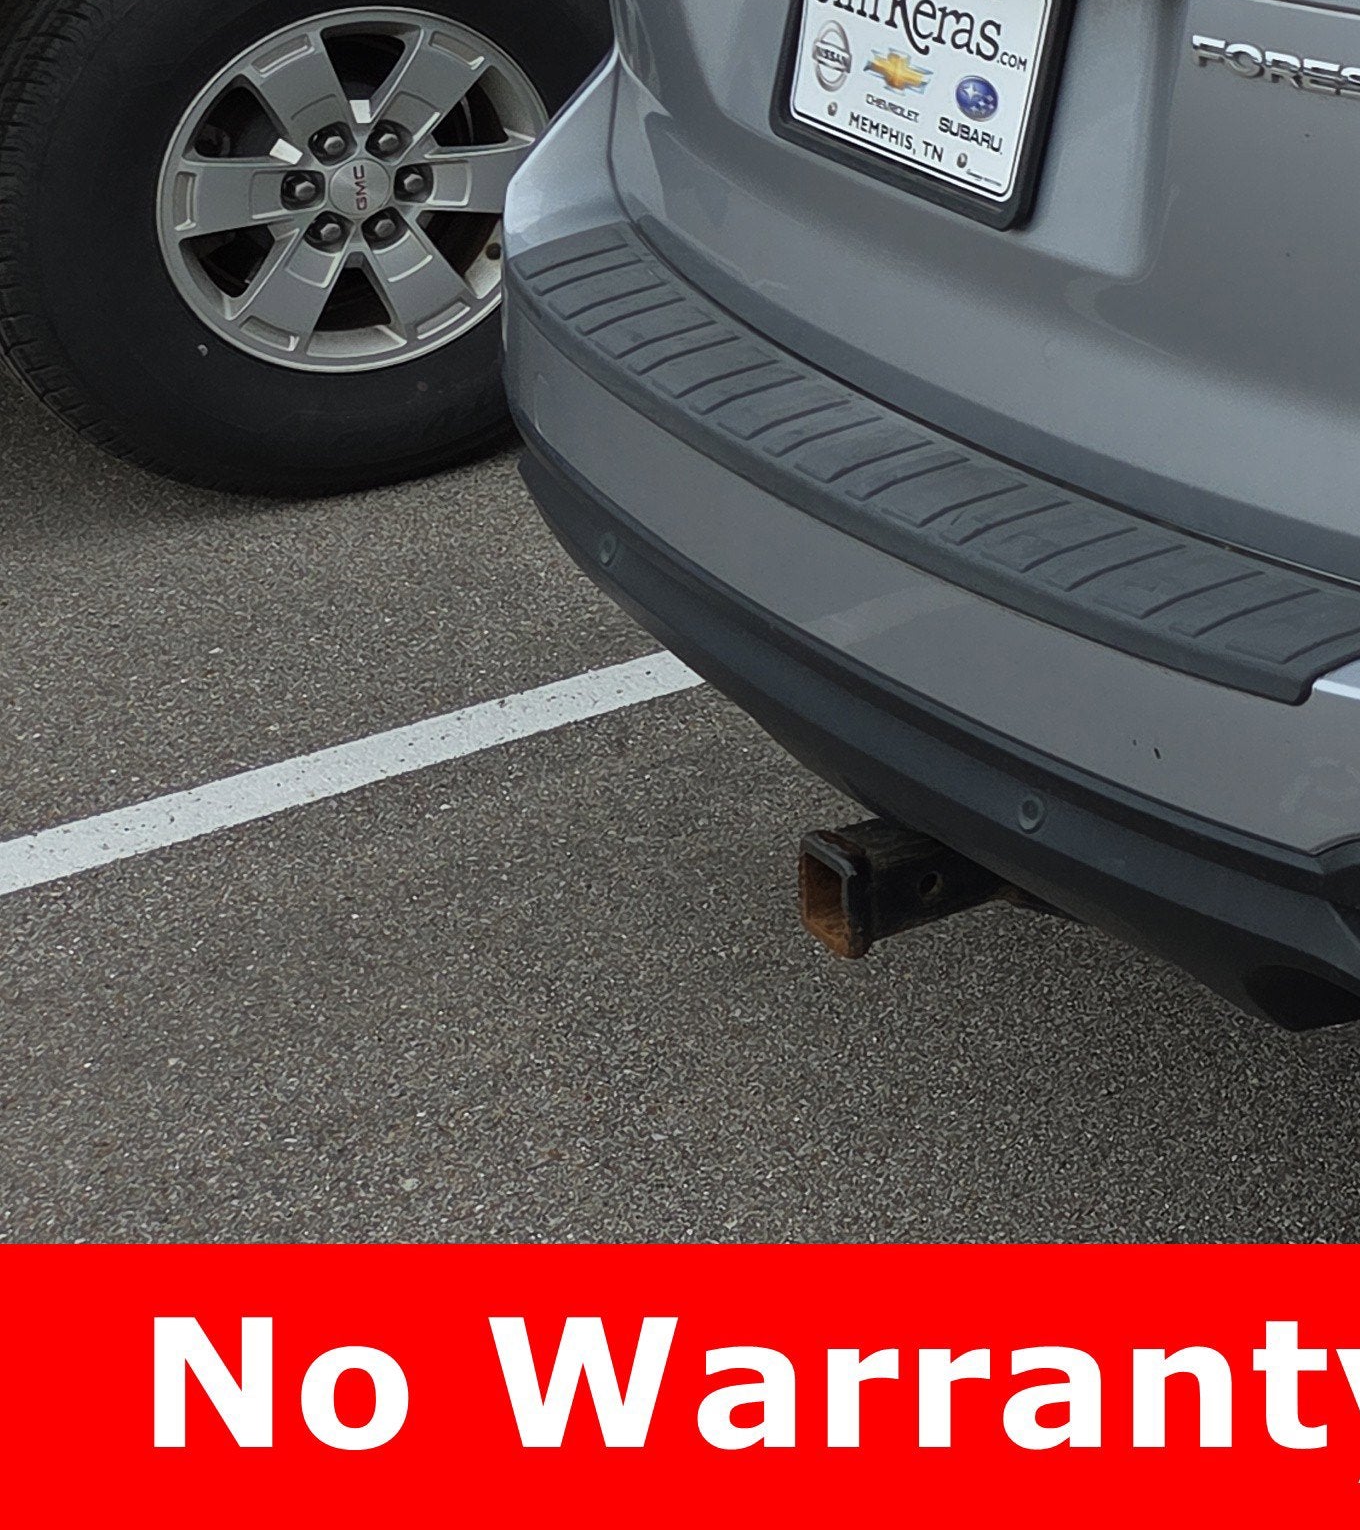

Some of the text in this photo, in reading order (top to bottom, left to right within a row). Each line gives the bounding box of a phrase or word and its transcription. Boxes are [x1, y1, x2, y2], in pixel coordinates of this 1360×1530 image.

[849, 111, 944, 163] MEMPHIS, TN
[353, 164, 368, 211] GMC
